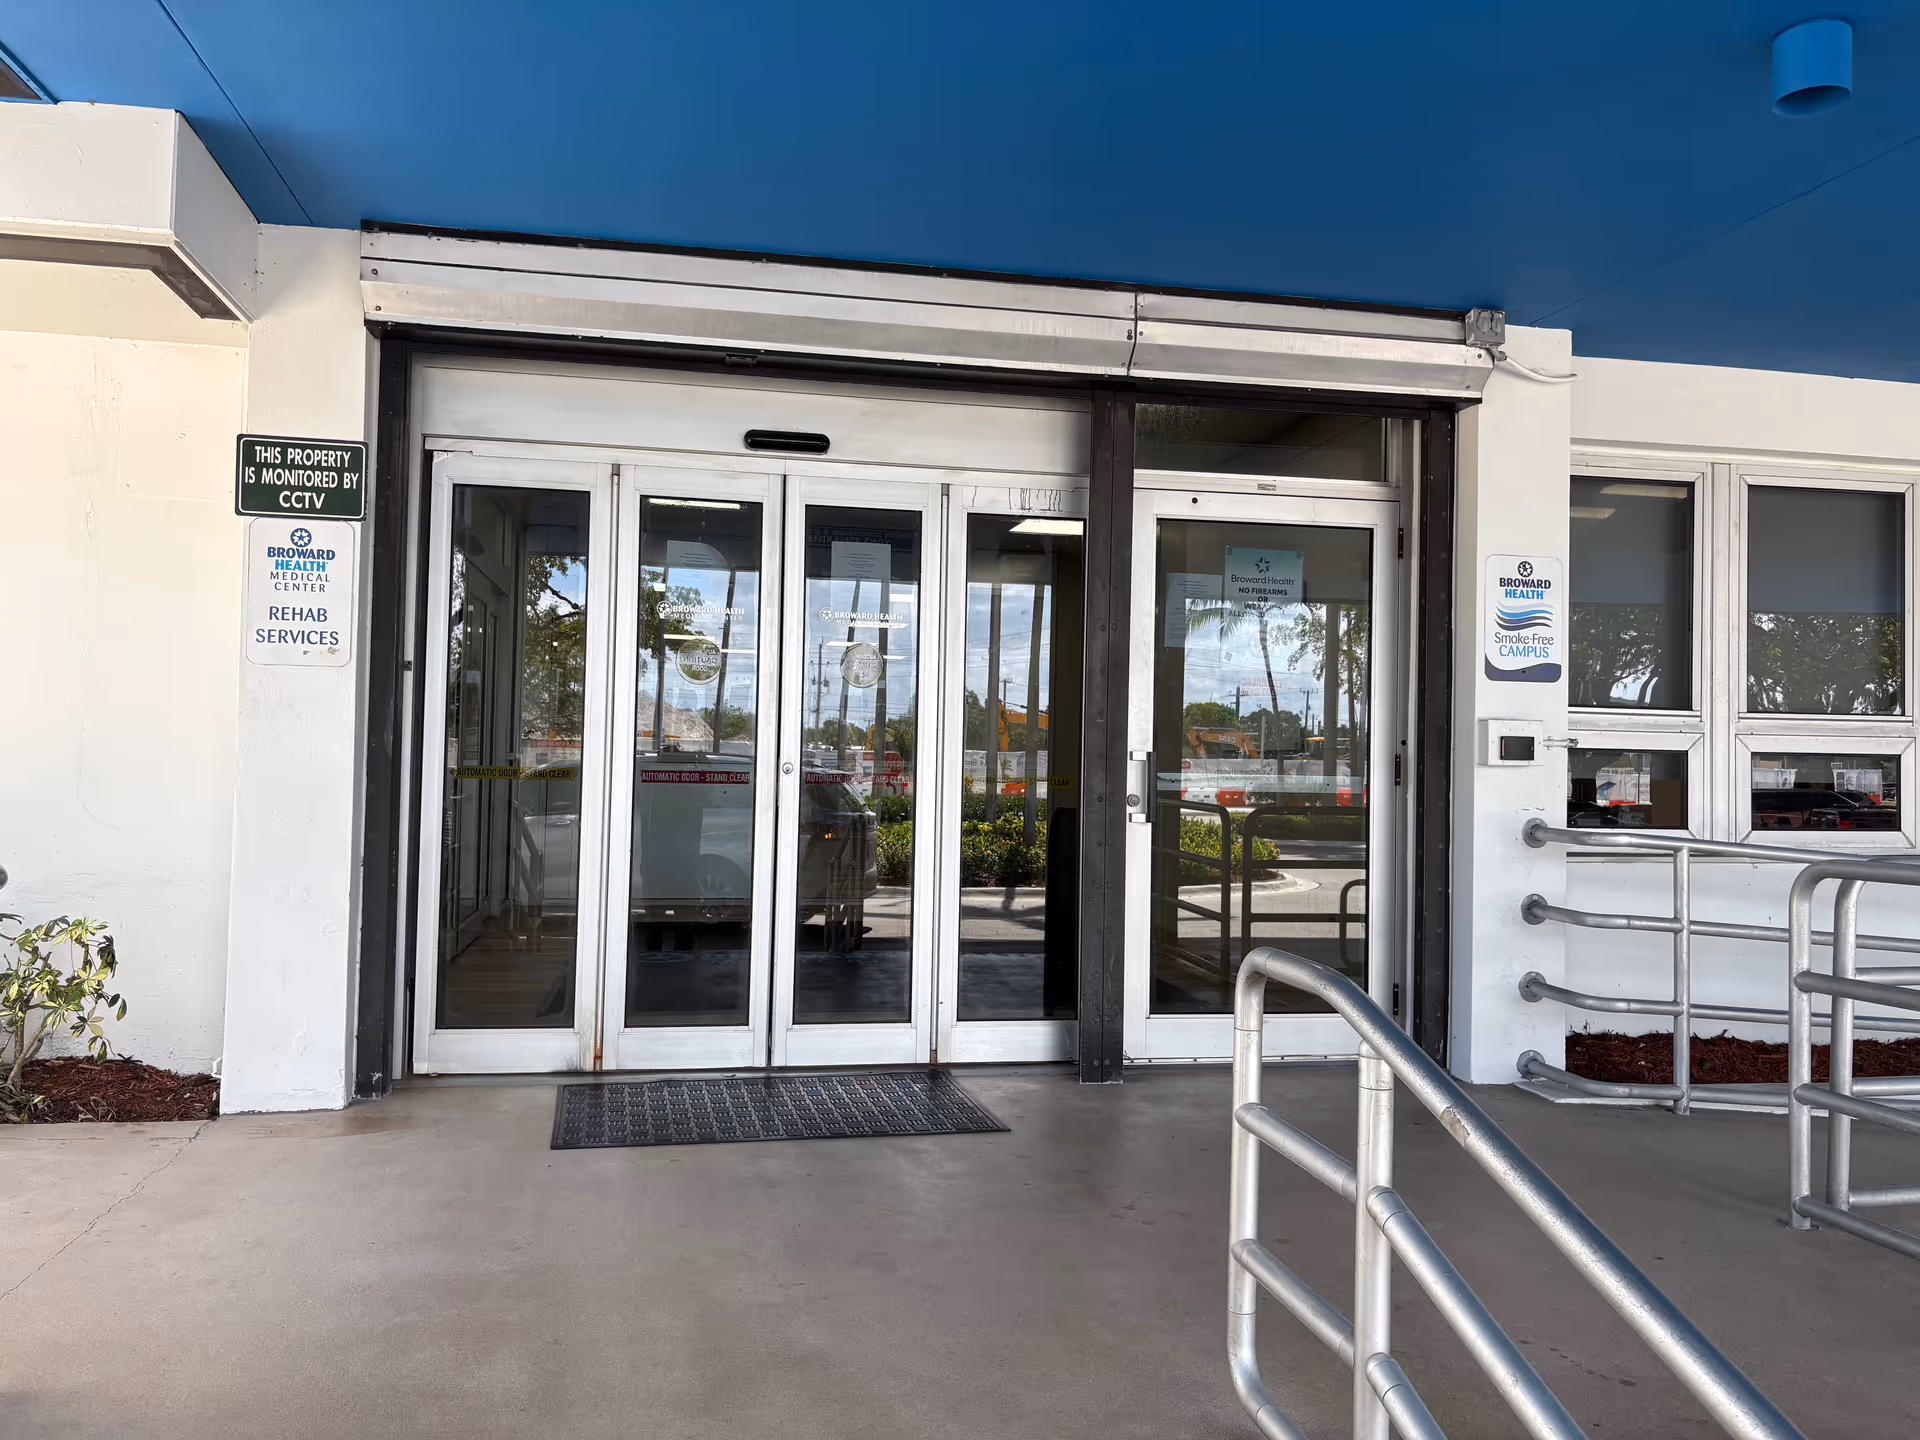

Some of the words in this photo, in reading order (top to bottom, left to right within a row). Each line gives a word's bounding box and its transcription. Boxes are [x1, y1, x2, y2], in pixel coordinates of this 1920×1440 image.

[255, 446, 281, 464] THIS
[287, 448, 351, 468] PROPERTY
[245, 467, 255, 484] IS
[261, 468, 338, 488] MONITORED
[343, 472, 359, 489] BY
[279, 491, 325, 509] CCTV
[267, 547, 336, 561] BROWARD
[275, 559, 327, 572] HEALTH
[270, 572, 330, 582] MEDICAL
[1499, 577, 1551, 590] BROWARD
[274, 582, 326, 593] CENTER
[1251, 588, 1288, 596] FIREARMS
[1504, 588, 1544, 600] HEALTH
[269, 606, 328, 622] REHAB
[672, 605, 712, 614] BROWARD
[714, 607, 744, 615] HEALTH
[834, 611, 872, 620] BROWARD
[874, 613, 903, 621] HEALTH
[255, 629, 339, 646] SERVICES
[1494, 632, 1554, 646] Smoke-Free
[1499, 644, 1549, 658] CAMPUS
[457, 768, 497, 777] AUTOMATIC
[499, 769, 518, 777] DOOR
[549, 770, 571, 778] CLEAR
[641, 772, 680, 781] AUTOMATIC
[681, 773, 700, 782] DOOR
[706, 773, 728, 782] STAND
[729, 774, 749, 783] CLEAR
[806, 774, 843, 782] AUTOMATIC
